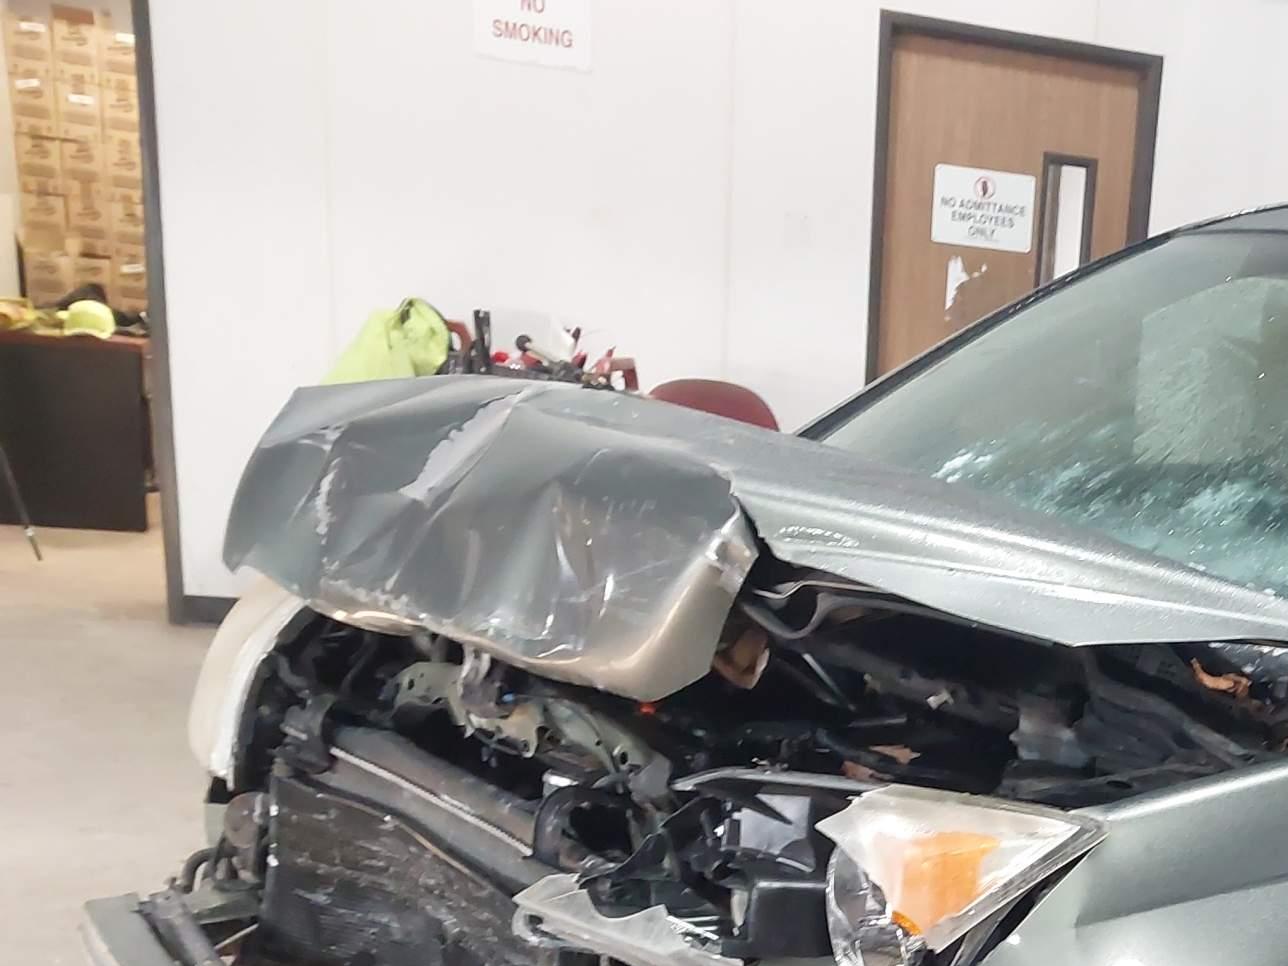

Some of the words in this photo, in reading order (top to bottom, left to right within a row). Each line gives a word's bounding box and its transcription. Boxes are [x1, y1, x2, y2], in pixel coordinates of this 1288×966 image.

[520, 0, 545, 13] NO
[492, 19, 573, 48] SMOKING
[941, 197, 956, 208] NO
[959, 199, 1025, 217] ADMITTANCE
[951, 210, 1015, 229] EMPLOYEES
[968, 225, 997, 240] ONLY
